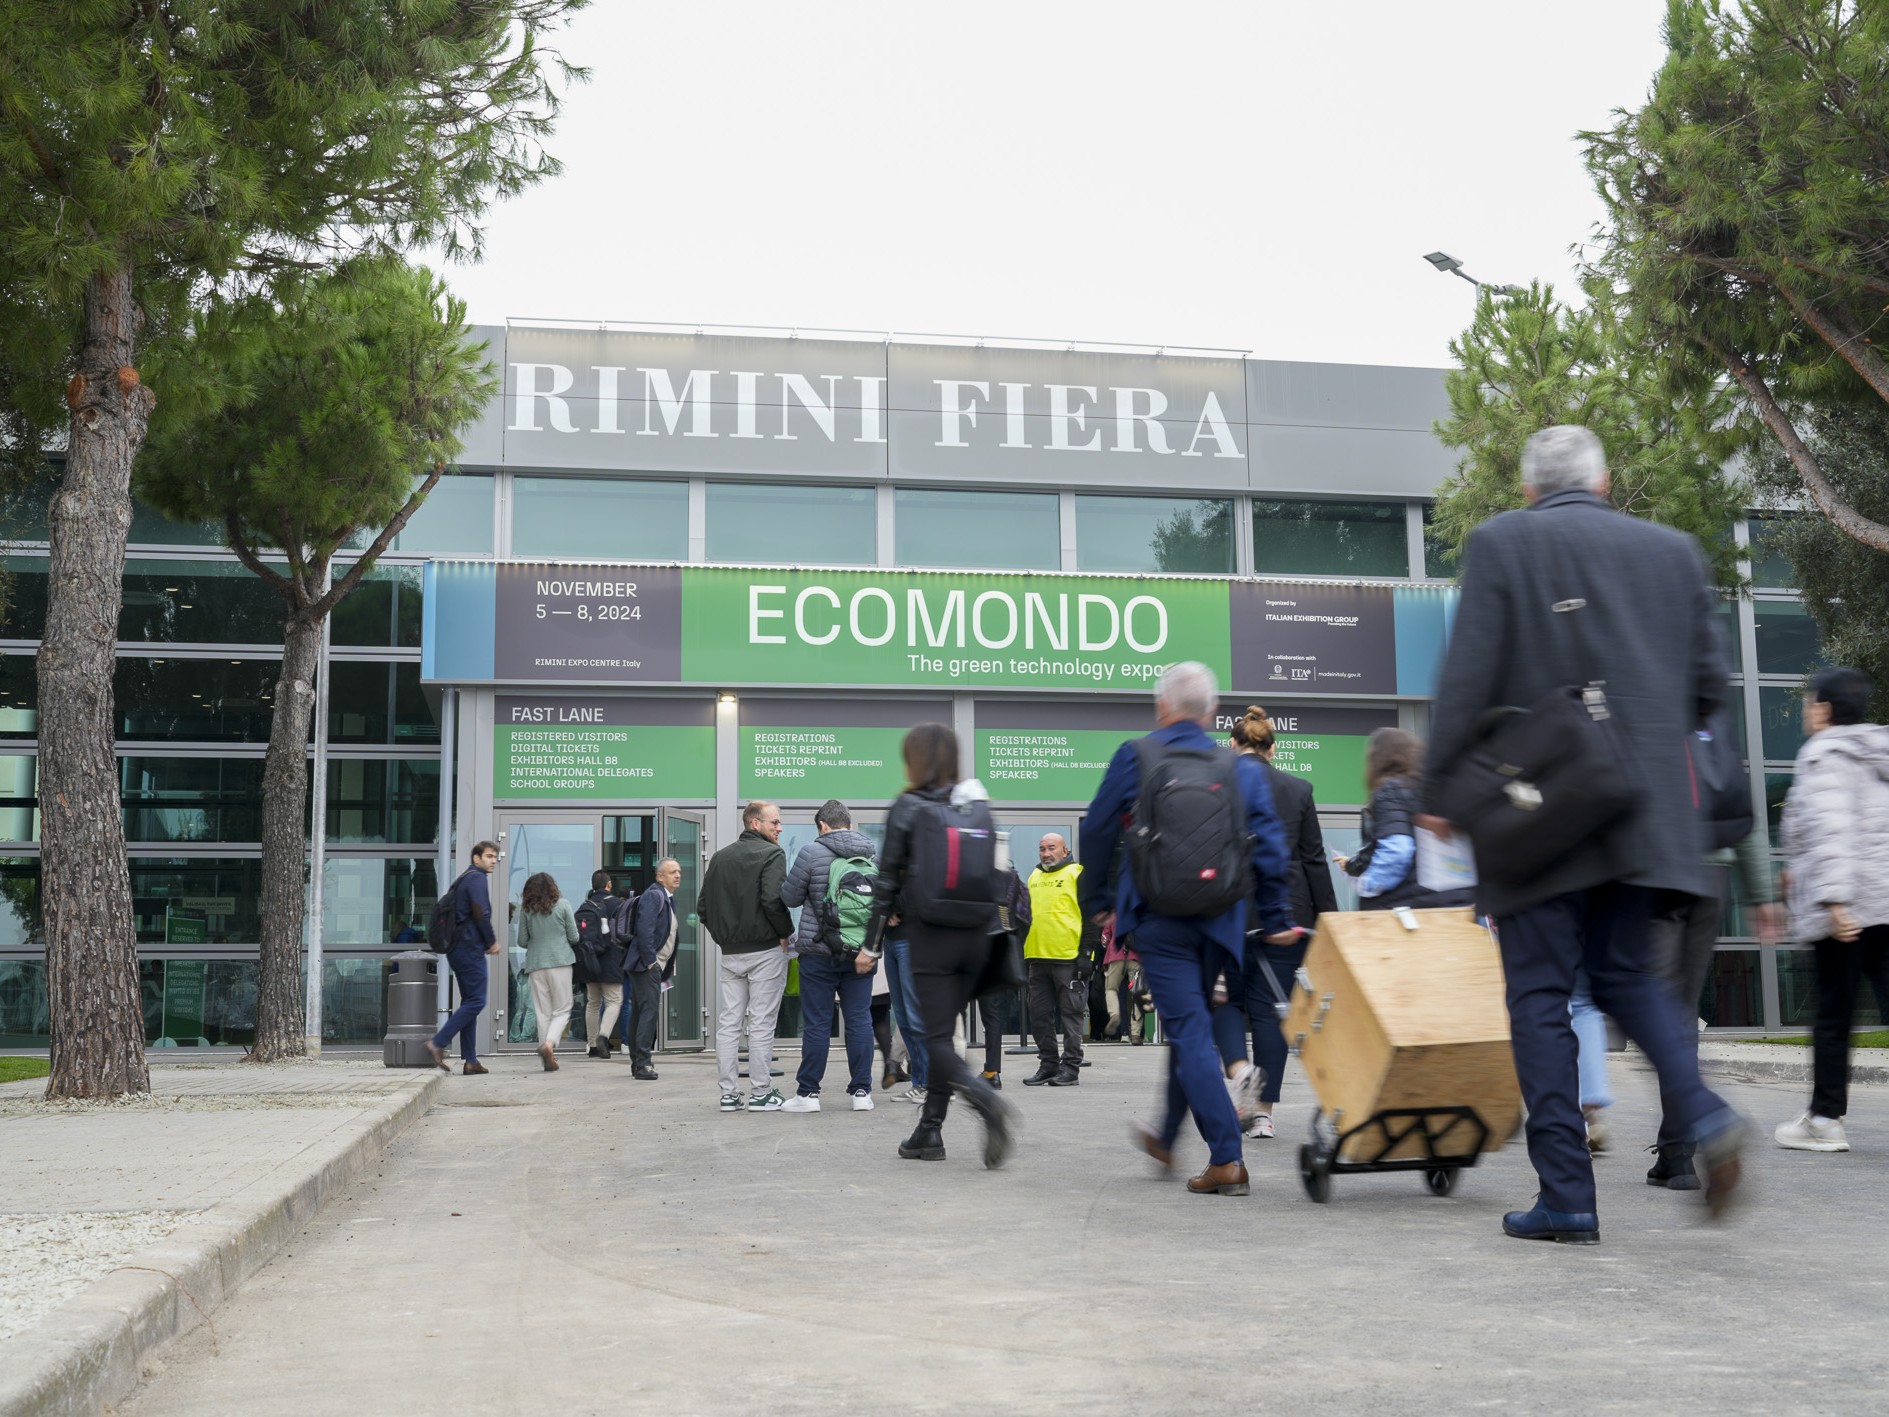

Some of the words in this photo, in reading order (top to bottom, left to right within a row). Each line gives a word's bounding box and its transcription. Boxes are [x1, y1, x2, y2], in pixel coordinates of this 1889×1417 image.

[507, 362, 887, 443] RIMINI
[932, 379, 1245, 458] FIERA
[536, 581, 637, 598] NOVEMBER
[536, 604, 546, 619] 5
[577, 605, 593, 622] 8,
[598, 605, 642, 621] 2024
[748, 585, 1168, 653] ECOMONDO
[535, 658, 567, 667] RIMINI
[568, 659, 589, 667] EXPO
[589, 659, 621, 668] CENTRE
[622, 659, 641, 669] Italy
[907, 654, 943, 672] The
[948, 657, 1003, 677] green
[1009, 658, 1114, 680] technology
[1121, 663, 1164, 681] expo
[511, 707, 554, 722] FAST
[559, 708, 604, 722] LANE
[511, 731, 575, 741] REGISTERED
[577, 732, 628, 742] VISITORS
[754, 733, 836, 743] REGISTRATIONS
[989, 735, 1067, 745] REGISTRATIONS
[511, 743, 554, 753] DIGITAL
[556, 744, 600, 753] TICKETS
[754, 745, 797, 754] TICKETS
[799, 746, 843, 755] REPRINT
[1274, 740, 1320, 750] VISITORS
[989, 747, 1030, 757] TICKETS
[1032, 748, 1075, 757] REPRINT
[510, 755, 575, 765] EXHIBITORS
[577, 756, 603, 765] HALL
[754, 757, 817, 766] EXHIBITORS
[989, 759, 1049, 768] EXHIBITORS
[510, 767, 595, 777] INTERNATIONAL
[597, 768, 654, 777] DELEGATES
[1275, 763, 1298, 771] HALL
[754, 768, 806, 778] SPEAKERS
[989, 770, 1039, 779] SPEAKERS
[510, 779, 552, 789] SCHOOL
[553, 779, 595, 789] GROUPS
